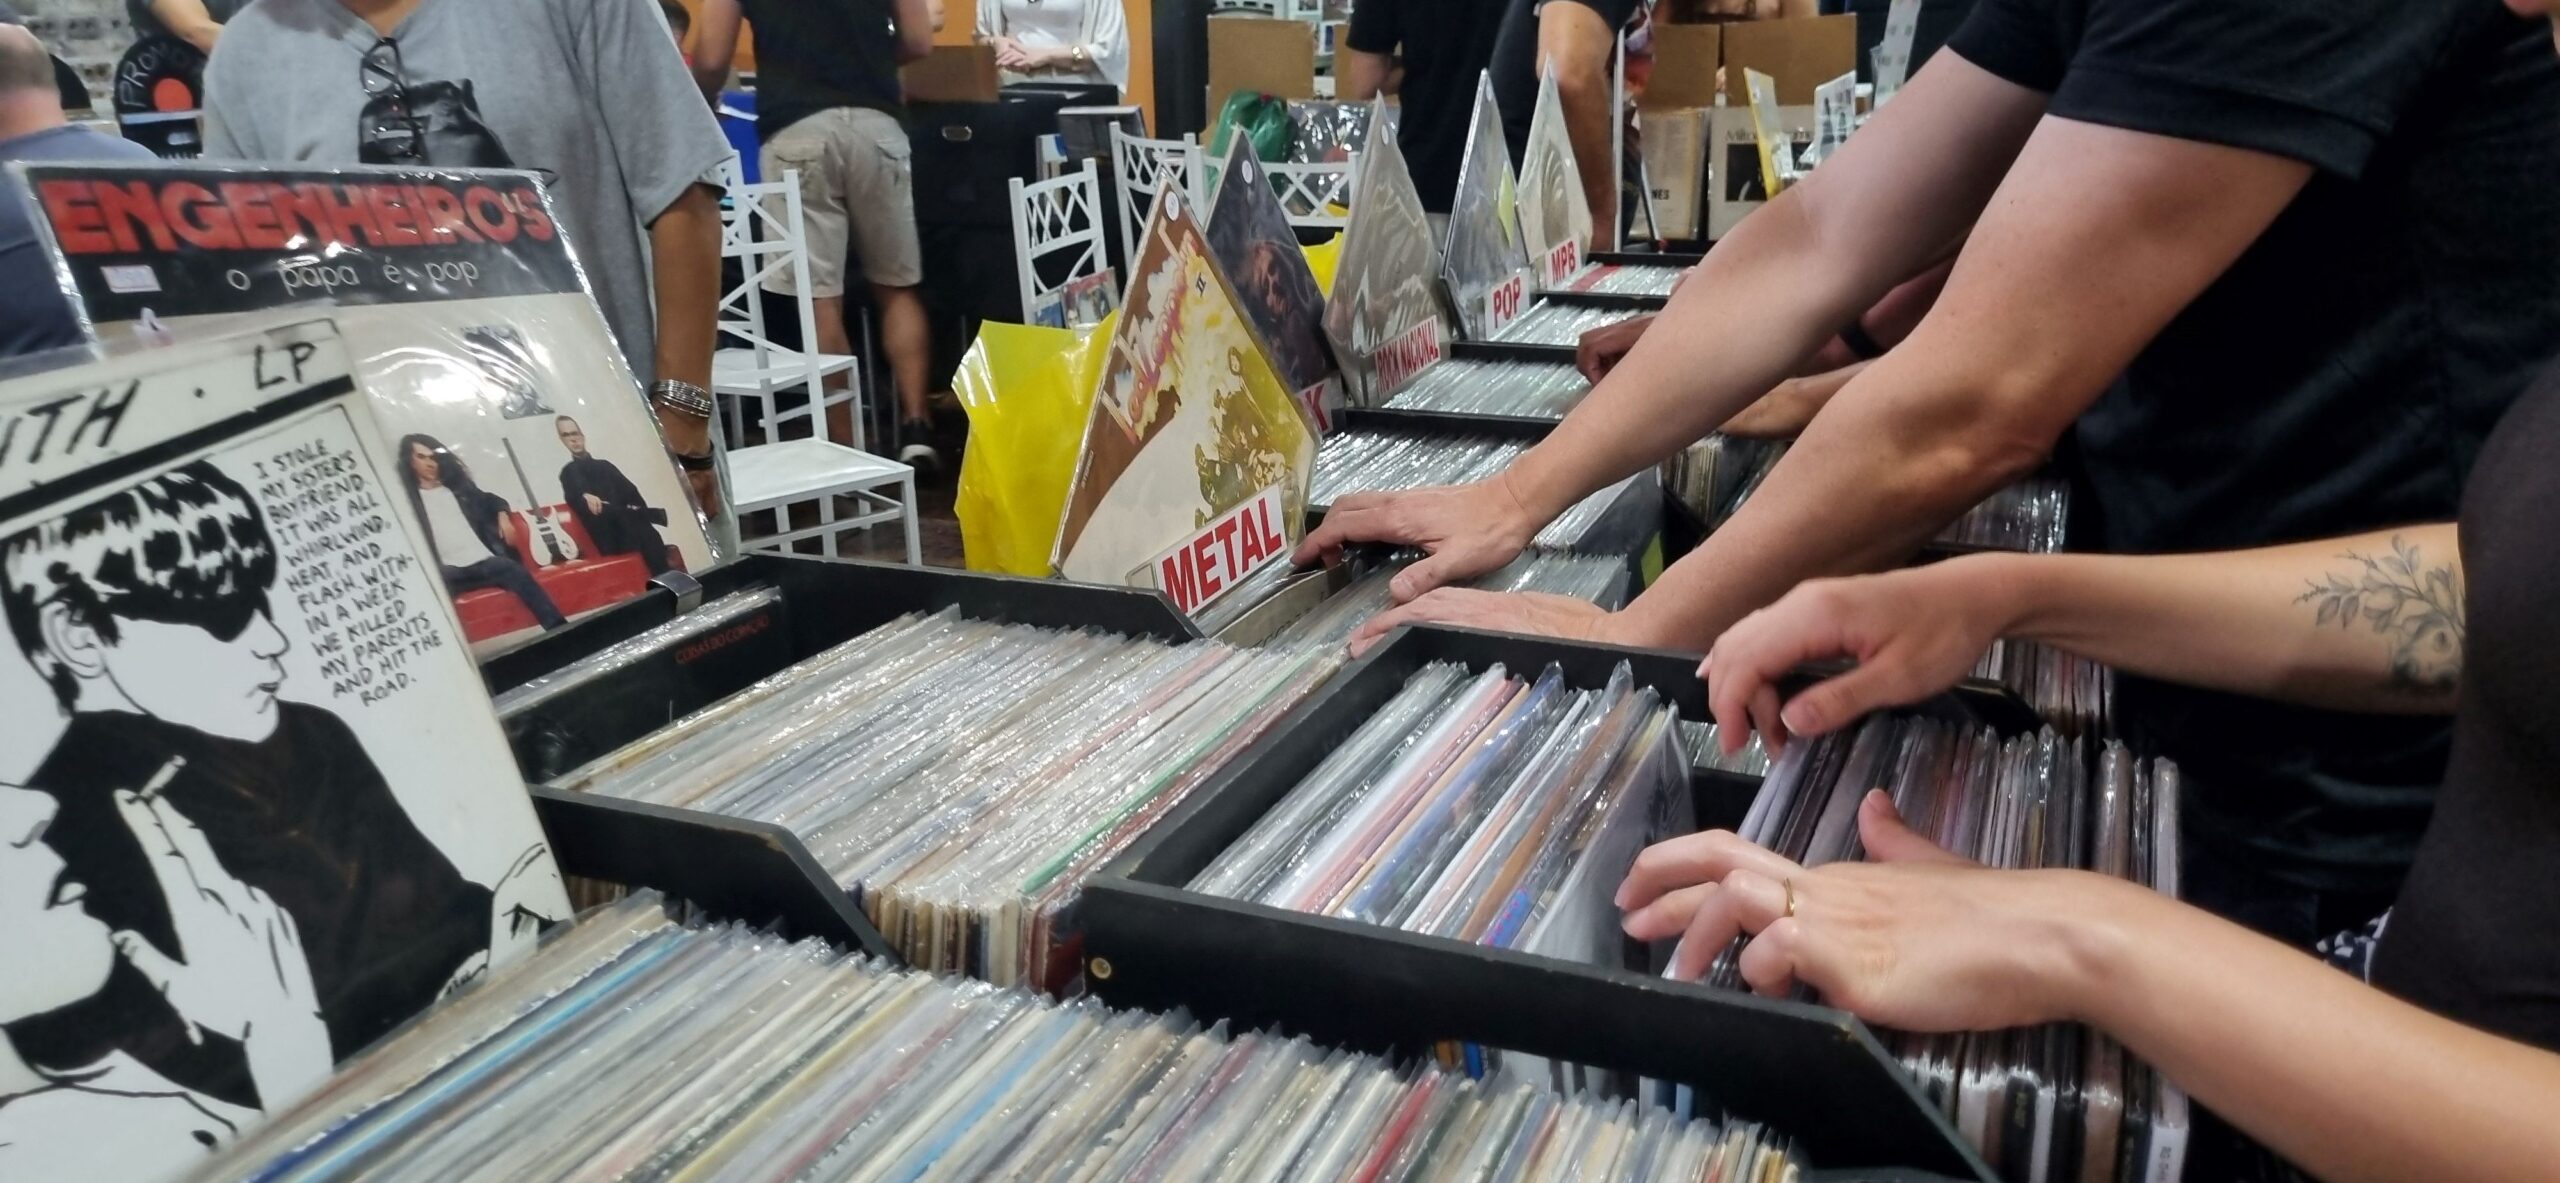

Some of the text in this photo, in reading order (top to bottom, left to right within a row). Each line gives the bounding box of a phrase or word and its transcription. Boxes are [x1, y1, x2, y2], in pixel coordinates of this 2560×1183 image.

[226, 256, 480, 297] o papa é pop
[1551, 240, 1576, 286] MPB
[1493, 275, 1521, 329] POP
[254, 340, 317, 390] LP
[1376, 318, 1439, 394] ROCK NACIONAL
[252, 438, 331, 480] I STOLE
[260, 478, 288, 500] MY
[275, 491, 380, 547] IT WAS ALL
[342, 542, 382, 571] AND
[1161, 496, 1283, 615] METAL
[305, 578, 407, 636] IN A WEEK
[311, 599, 407, 658] WE KILLED
[320, 610, 433, 680] MY PARENTS
[332, 629, 443, 700] AND HIT THE
